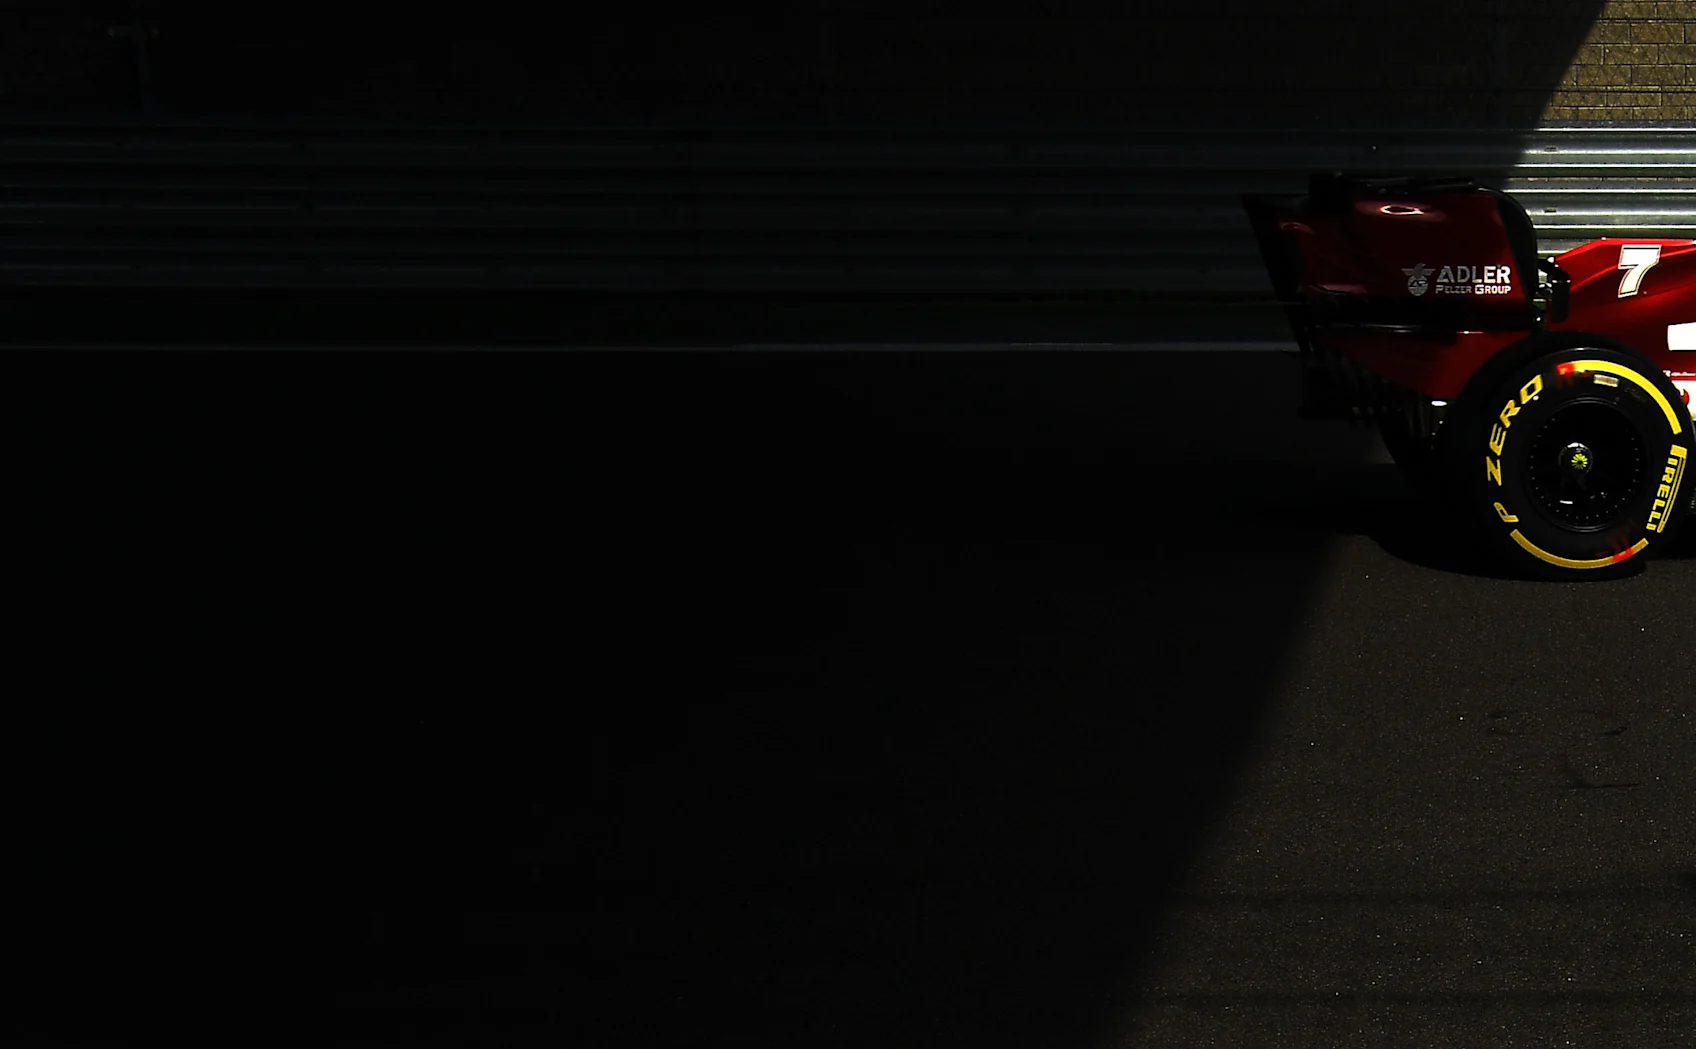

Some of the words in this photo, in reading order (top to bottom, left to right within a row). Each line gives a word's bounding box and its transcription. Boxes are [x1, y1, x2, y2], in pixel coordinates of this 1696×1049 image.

[1435, 285, 1472, 294] PELZER
[1474, 284, 1512, 295] GROUP
[1436, 265, 1511, 284] ADLER
[1618, 244, 1662, 298] 7
[1485, 373, 1544, 487] ZERO
[1645, 444, 1688, 534] PIRELLI
